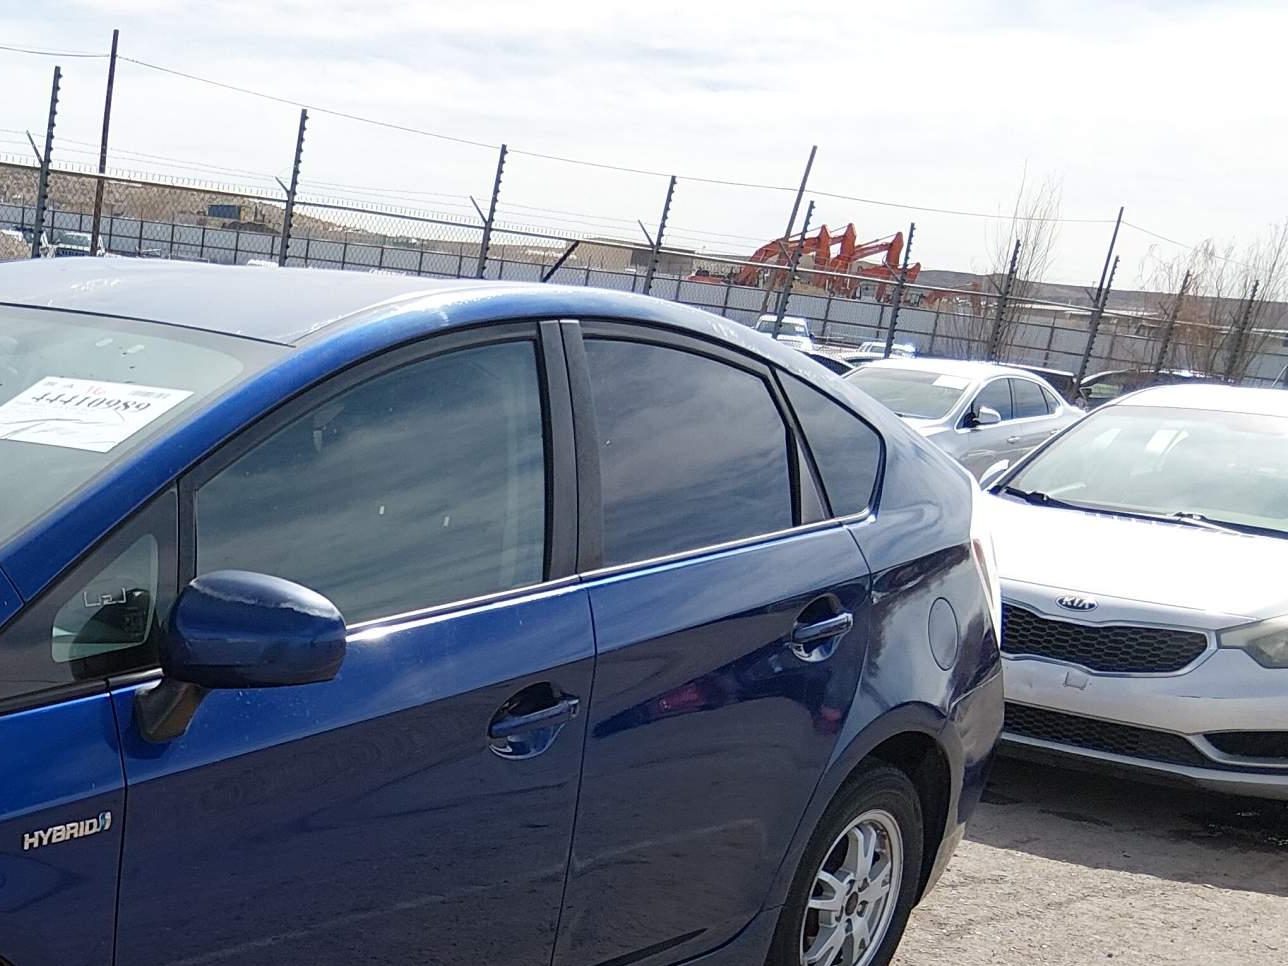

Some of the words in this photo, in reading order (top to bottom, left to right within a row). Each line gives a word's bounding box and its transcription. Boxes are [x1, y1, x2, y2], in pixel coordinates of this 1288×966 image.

[31, 391, 151, 412] 44410989
[1062, 597, 1090, 609] KIA
[23, 817, 100, 850] HYBRID
